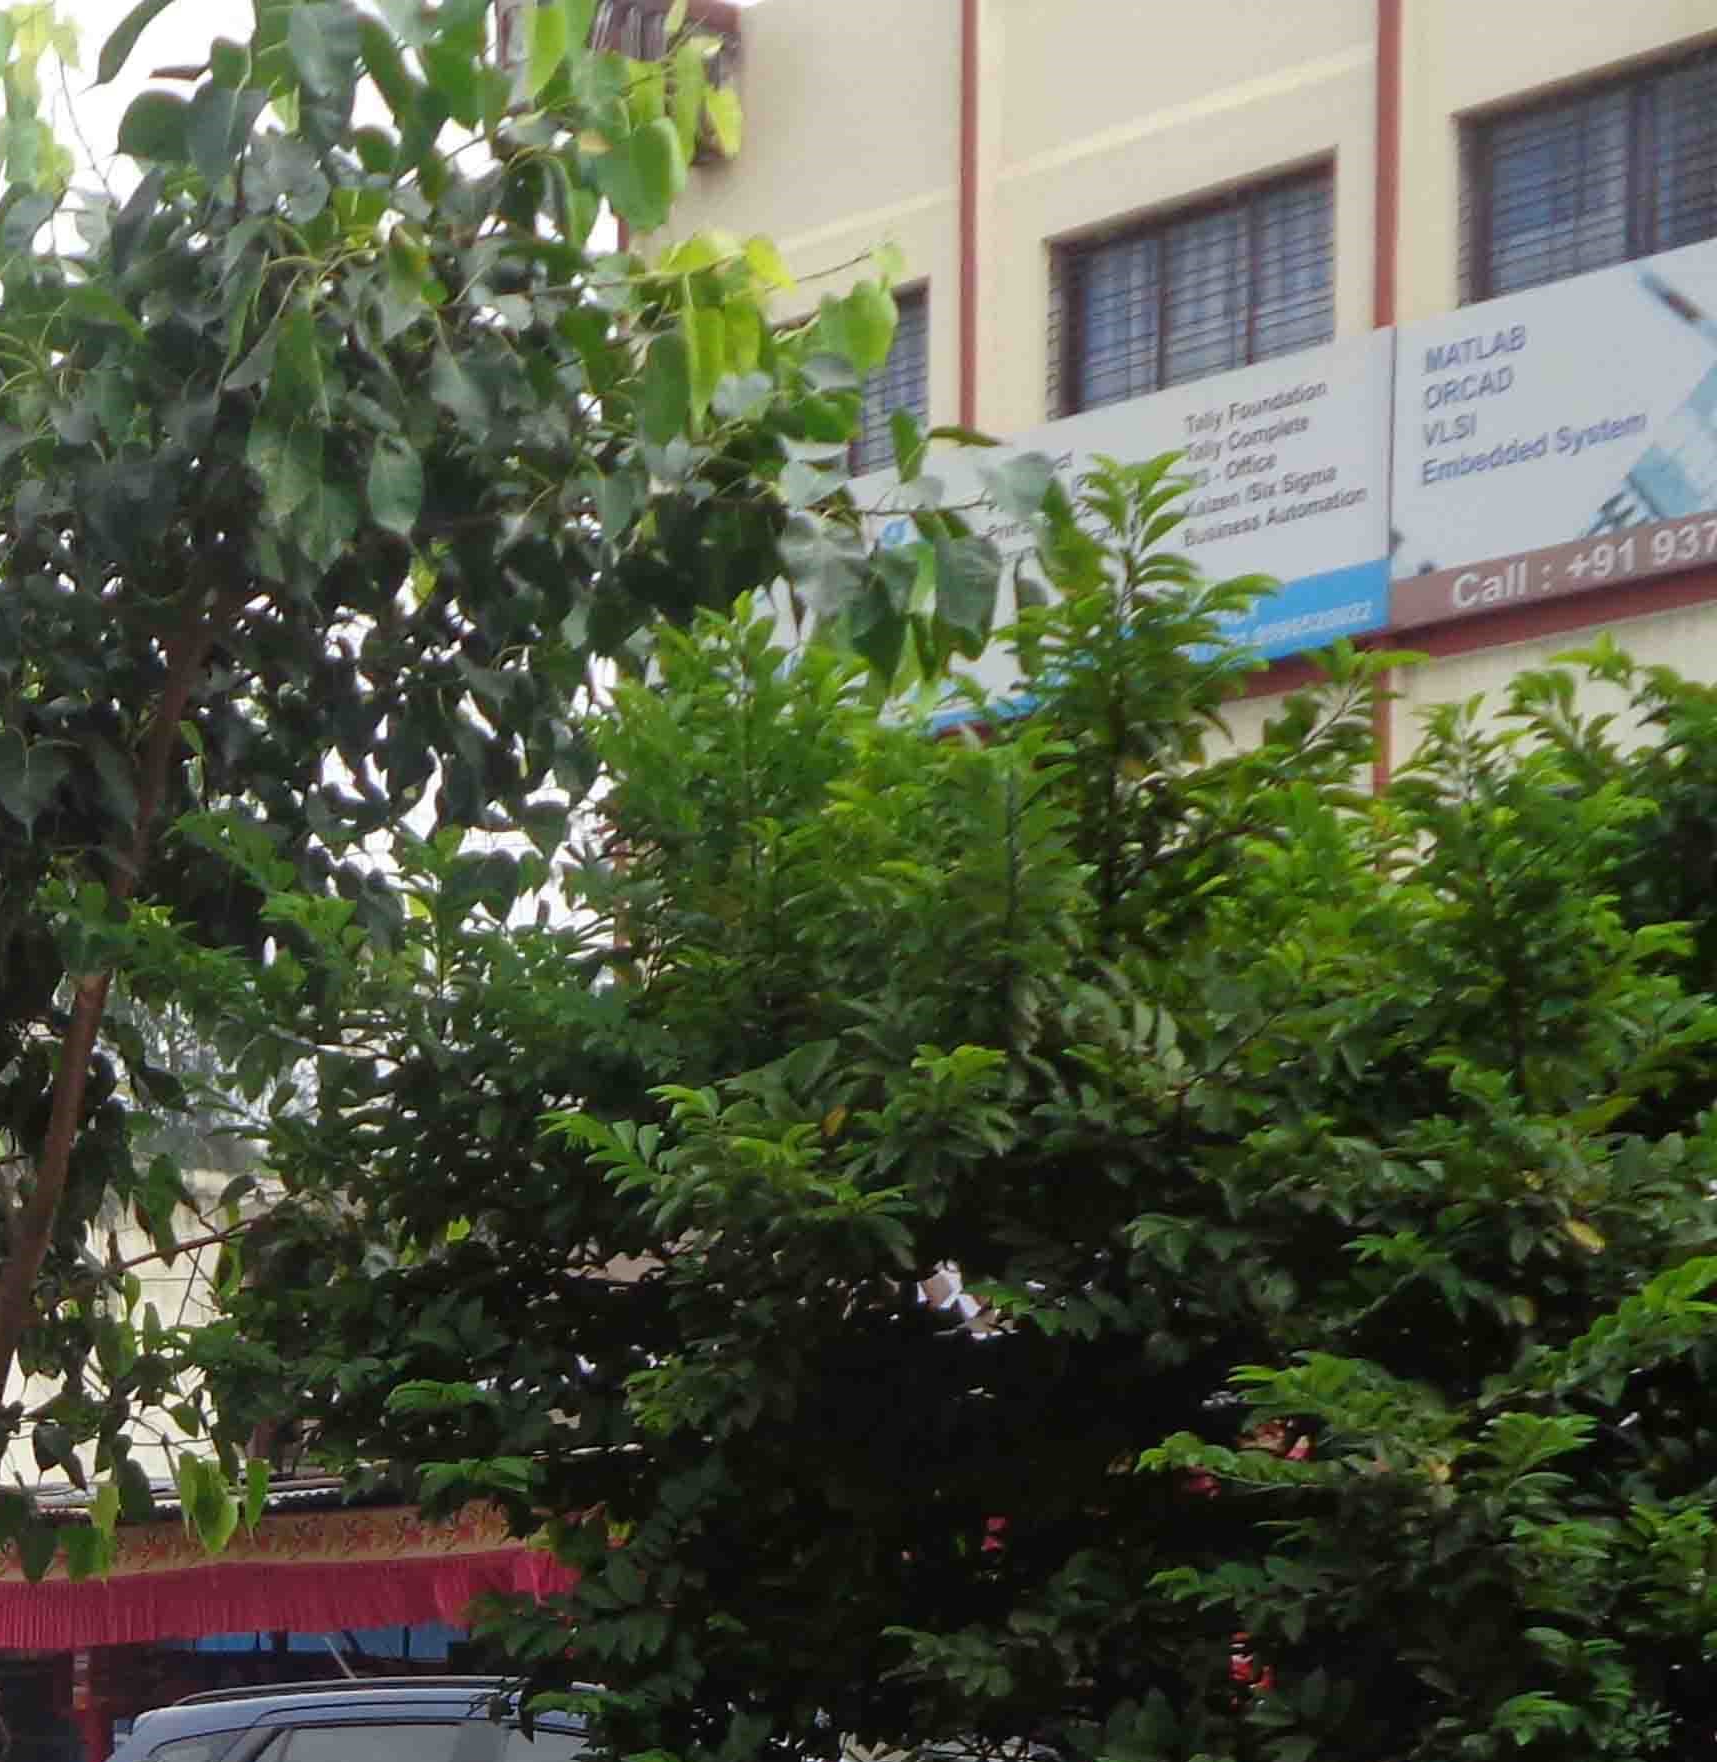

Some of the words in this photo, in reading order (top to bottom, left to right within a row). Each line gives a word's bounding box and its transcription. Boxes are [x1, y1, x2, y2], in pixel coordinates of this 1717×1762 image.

[1424, 325, 1526, 373] MATLAB
[1184, 410, 1223, 433] Tally
[1228, 381, 1327, 424] Foundation
[1423, 366, 1514, 411] ORCAD
[1184, 439, 1223, 463] Tally
[1228, 415, 1309, 451] Complete
[1421, 431, 1548, 486] Embedded
[1555, 412, 1646, 456] System
[1422, 412, 1477, 447] VLSI
[1225, 453, 1278, 481] Office
[1282, 465, 1338, 495] Sigma
[1183, 513, 1261, 547] Business
[1266, 486, 1368, 526] Automation
[1452, 560, 1527, 609] Call
[1564, 536, 1637, 580] +91
